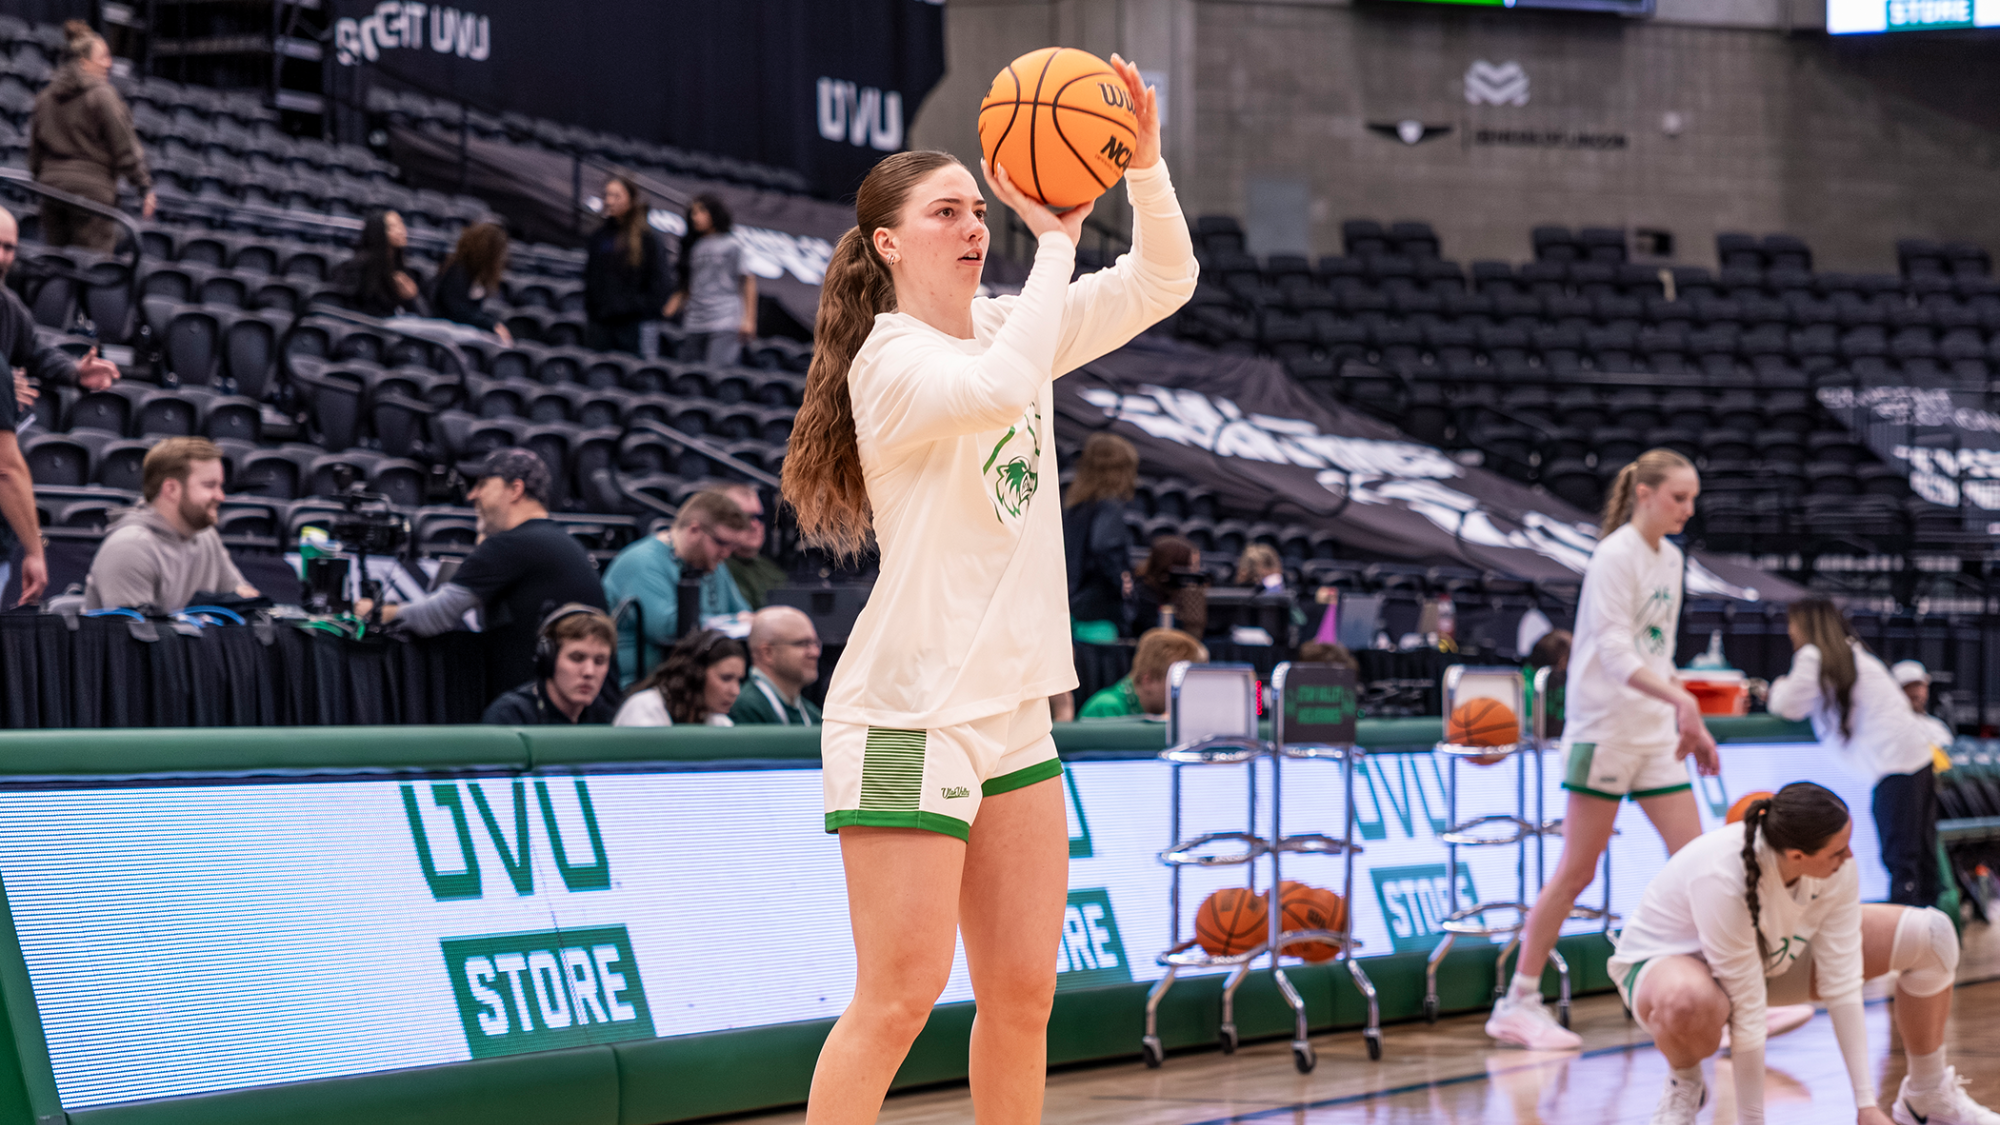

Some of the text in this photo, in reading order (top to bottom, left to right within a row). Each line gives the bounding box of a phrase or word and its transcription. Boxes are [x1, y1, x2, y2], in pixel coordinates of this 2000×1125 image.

[817, 76, 903, 151] UVU
[1100, 134, 1132, 173] NCA
[400, 779, 612, 901] UVU
[464, 943, 638, 1036] STORE
